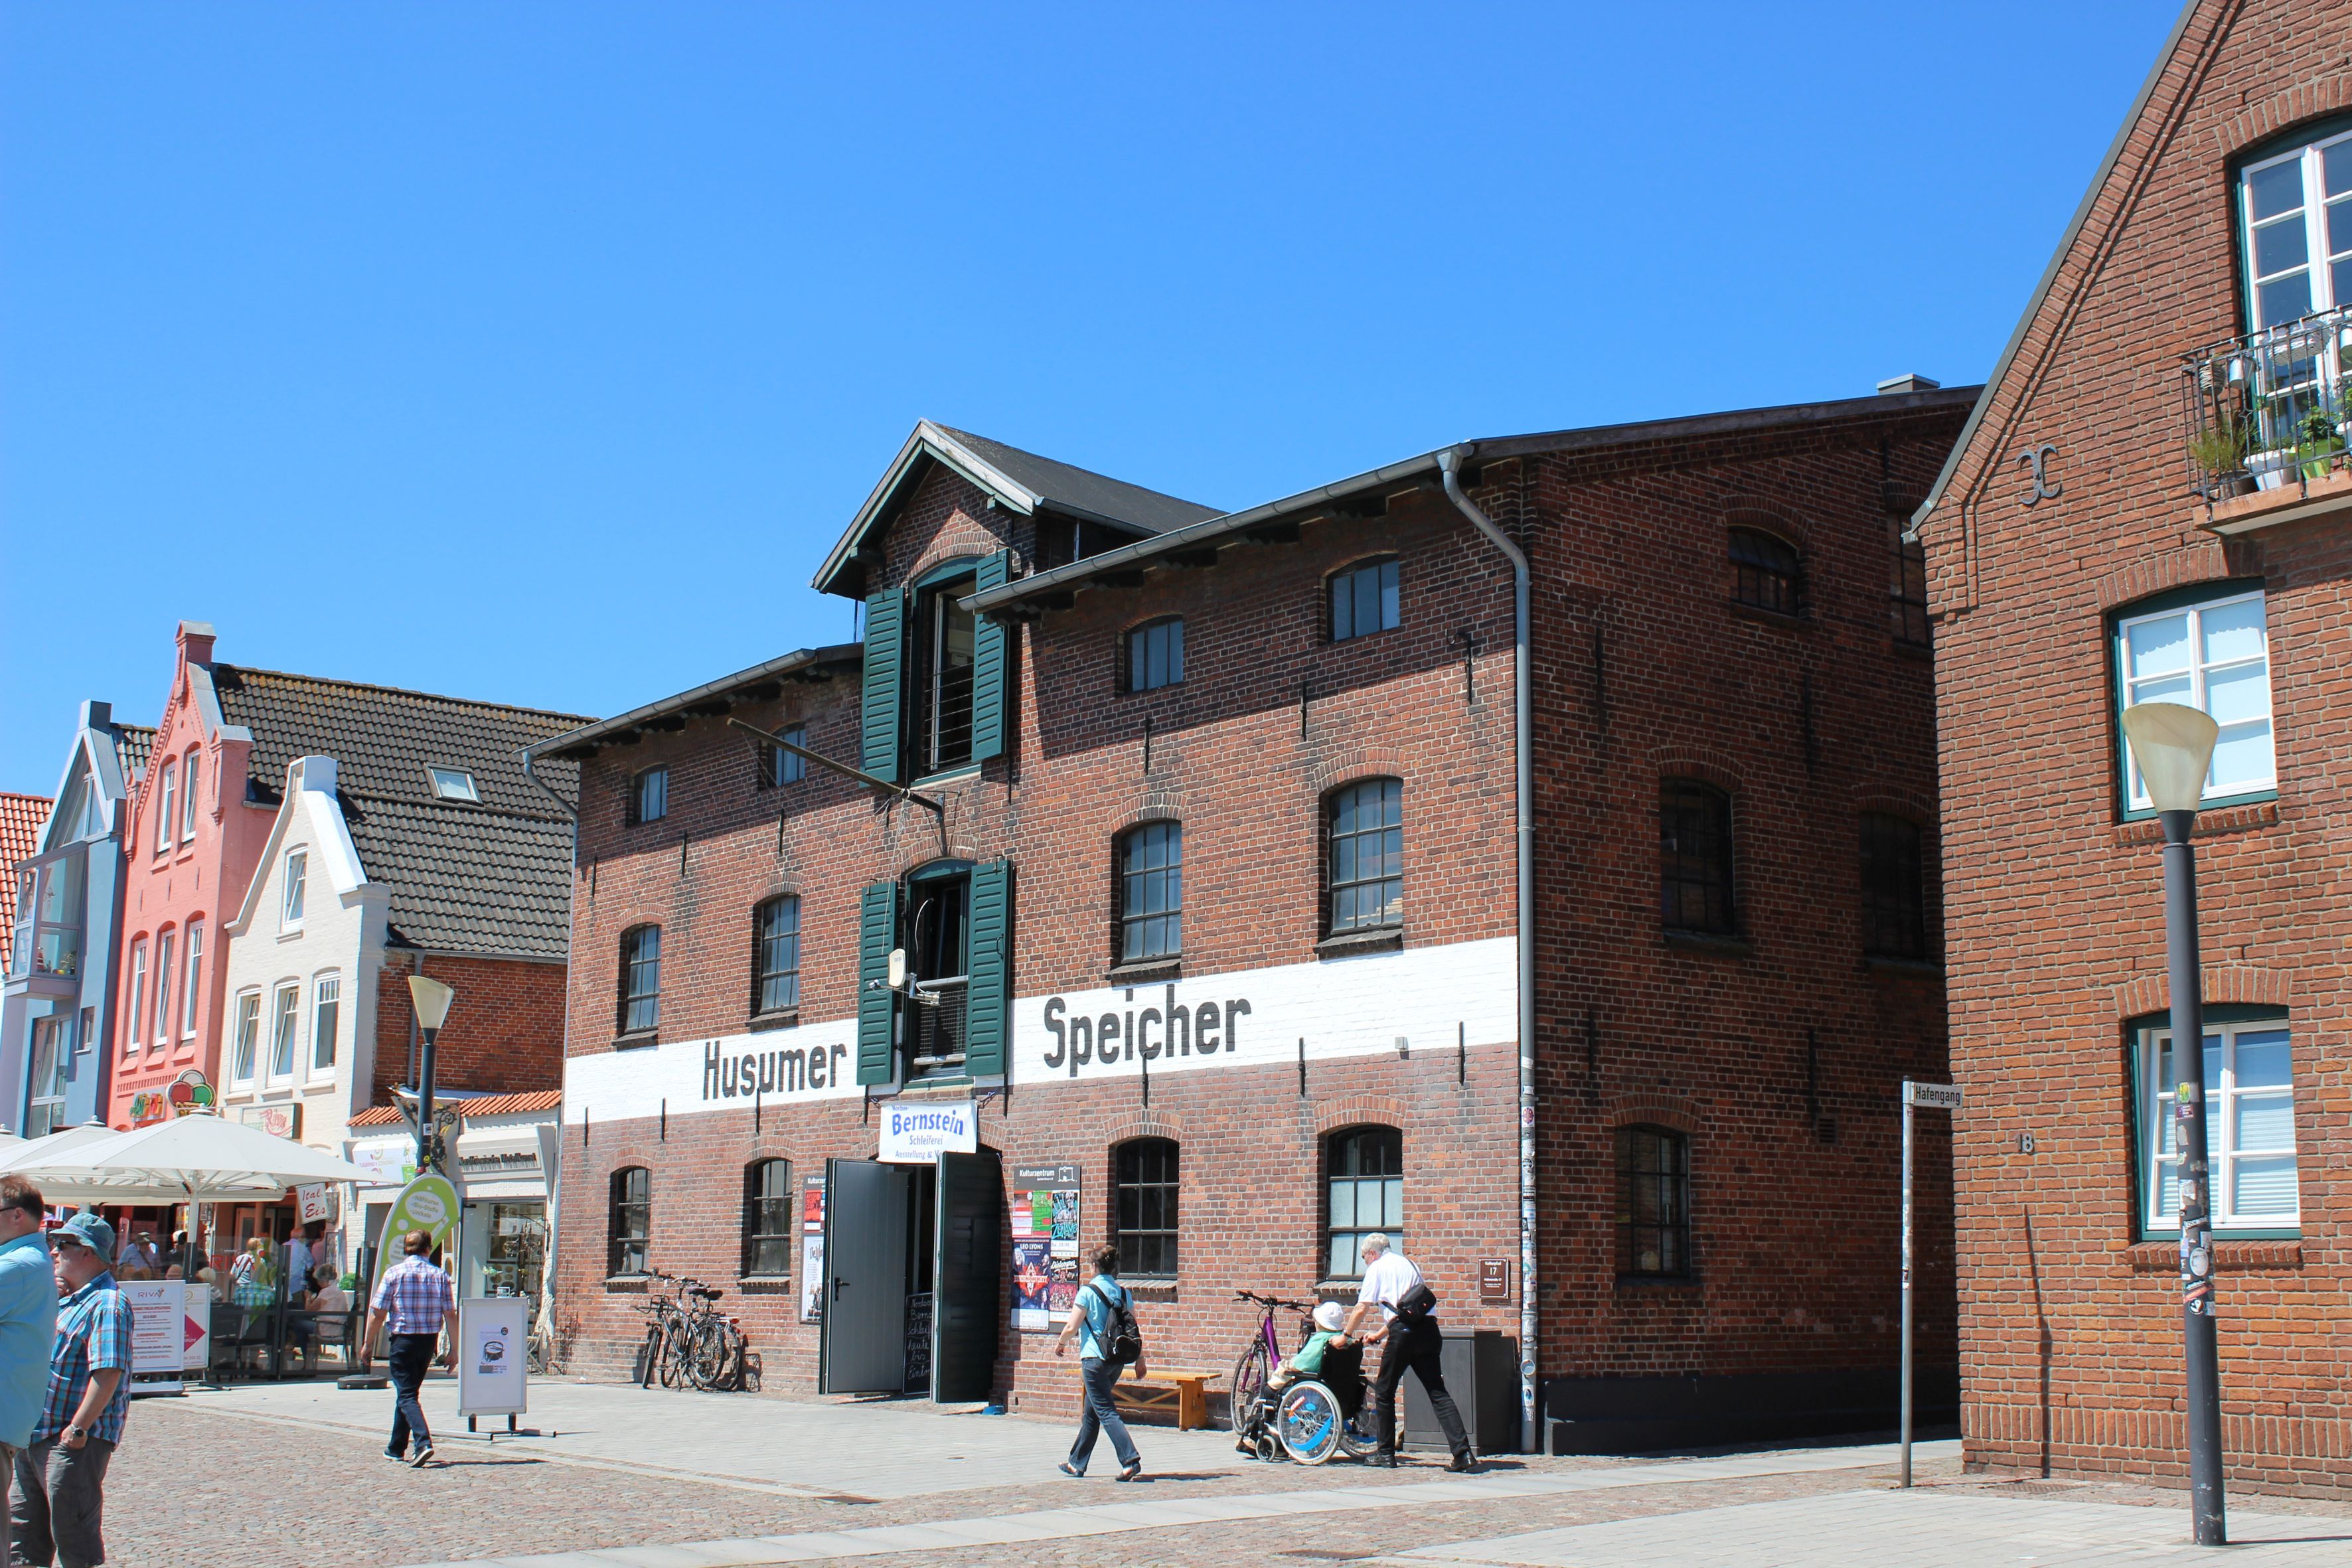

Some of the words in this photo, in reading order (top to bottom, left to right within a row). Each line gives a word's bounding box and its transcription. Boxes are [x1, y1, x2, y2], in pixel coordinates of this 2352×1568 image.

[1044, 983, 1252, 1077] Speicher
[703, 1040, 847, 1100] Husumer
[1915, 1085, 1960, 1106] Hafengang
[892, 1109, 964, 1137] Bernstein
[909, 1135, 943, 1146] Schleiferei
[895, 1149, 926, 1160] Ausstellung
[1019, 1168, 1055, 1178] Kulturzentrum
[301, 1189, 325, 1202] Ital.
[305, 1202, 326, 1219] Eis
[1490, 1267, 1498, 1275] 17
